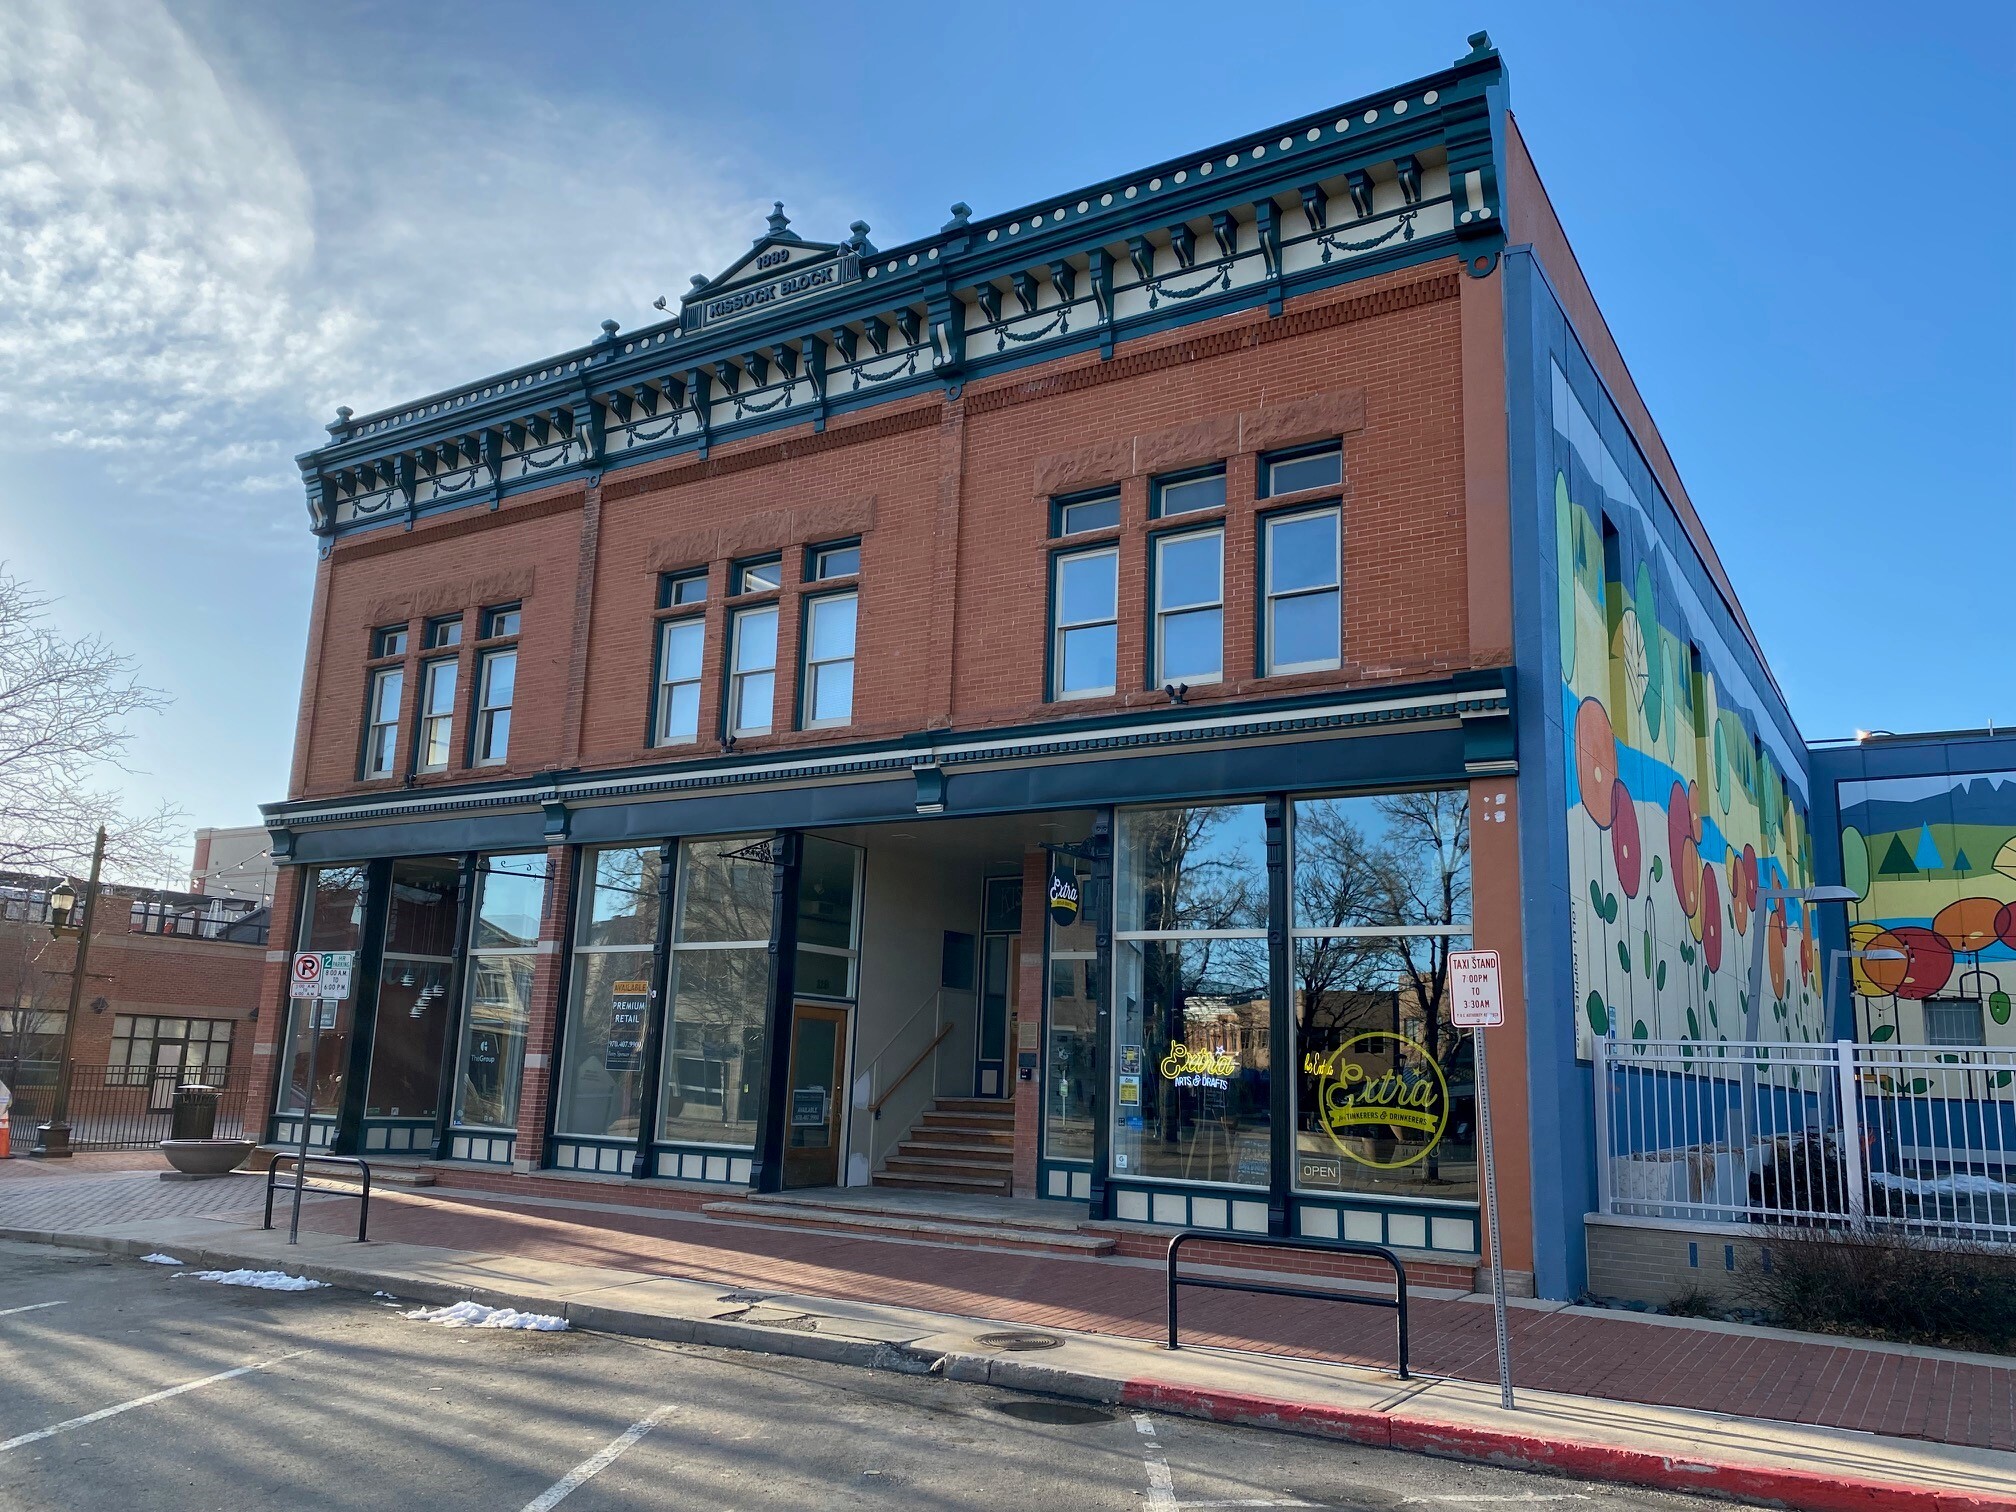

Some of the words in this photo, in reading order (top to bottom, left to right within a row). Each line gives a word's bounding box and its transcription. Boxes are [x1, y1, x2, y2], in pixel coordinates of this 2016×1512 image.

[755, 249, 790, 270] 1889
[709, 285, 776, 318] KISSOCK
[780, 267, 833, 296] BLOCK
[1050, 876, 1078, 901] Extra
[325, 956, 332, 968] 2
[1453, 960, 1470, 970] TAXI
[1472, 958, 1496, 969] STAND
[1462, 975, 1488, 983] 7:00PM
[614, 983, 647, 992] AVAILABLE
[1471, 987, 1480, 995] TO
[613, 1001, 645, 1010] PREMIUM
[1464, 1000, 1490, 1008] 3:30AM
[615, 1014, 640, 1023] RETAIL
[1161, 1039, 1236, 1079] Extra
[1175, 1076, 1192, 1087] ARTS
[1193, 1075, 1202, 1086] &
[1202, 1077, 1228, 1090] DRAFTS
[1326, 1057, 1438, 1110] Extra
[1346, 1111, 1379, 1120] TINKERERS
[1380, 1111, 1388, 1120] &
[1389, 1113, 1427, 1126] DRINKERERS
[1303, 1165, 1336, 1178] OPEN
